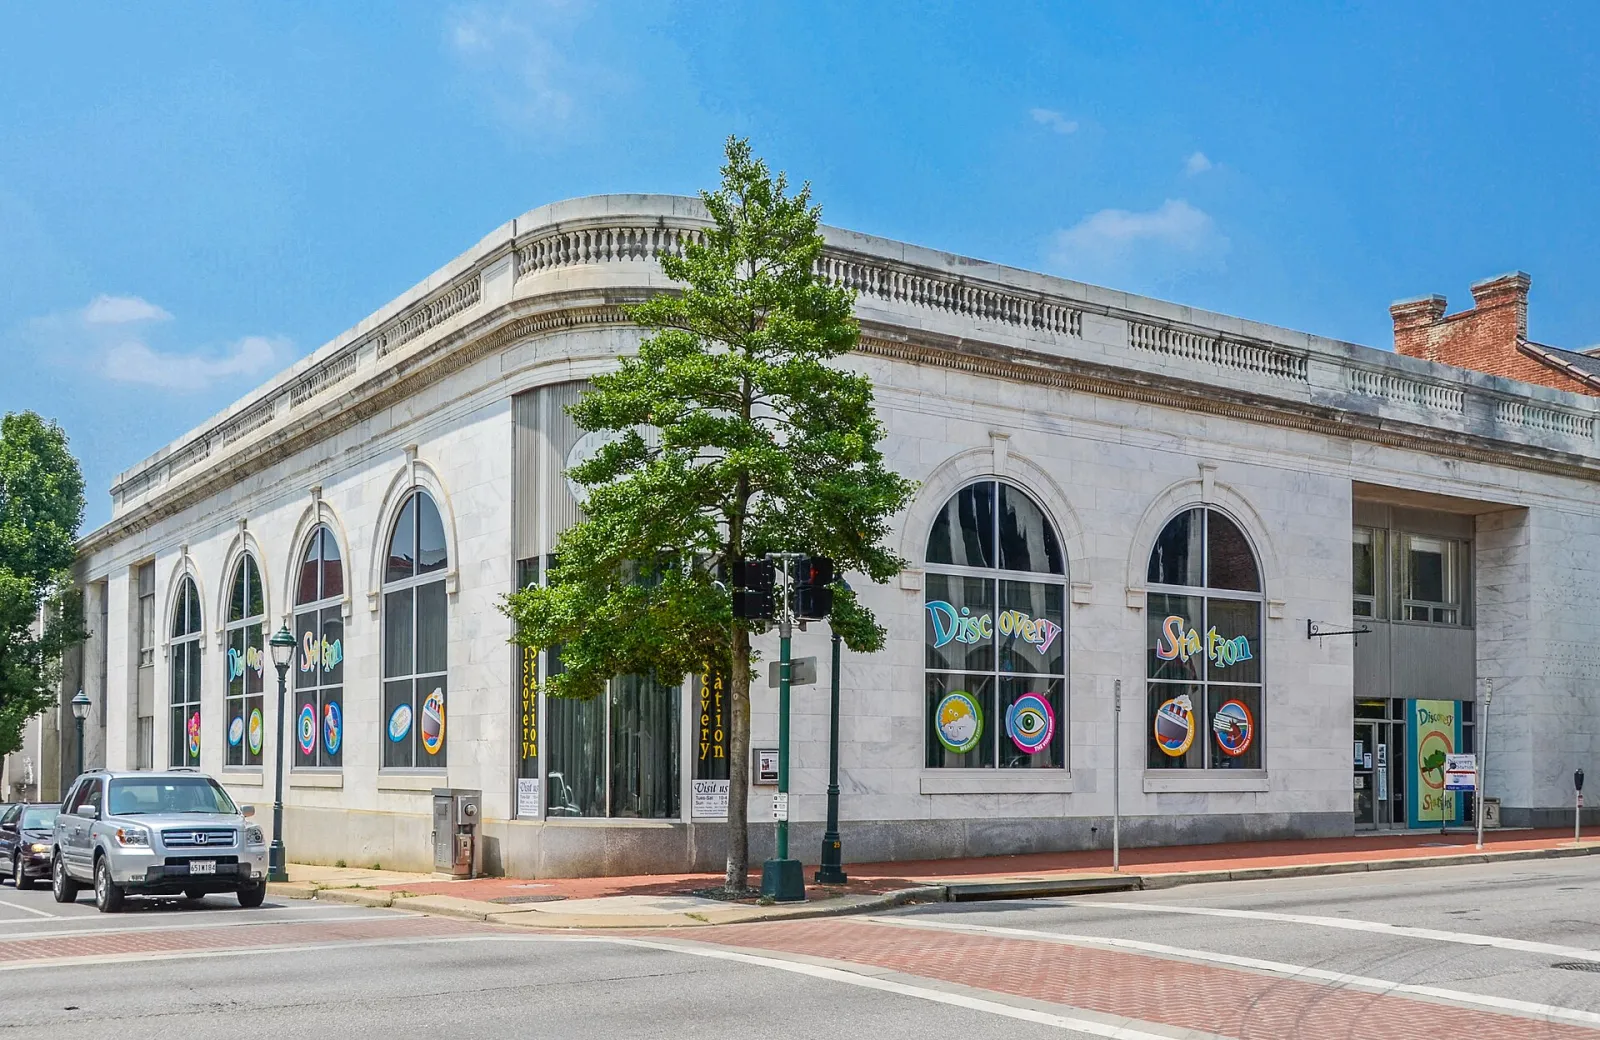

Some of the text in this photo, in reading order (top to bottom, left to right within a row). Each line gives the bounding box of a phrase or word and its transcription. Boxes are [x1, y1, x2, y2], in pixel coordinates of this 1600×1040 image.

[925, 600, 1253, 668] Discovery Station
[694, 781, 728, 793] Visit us
